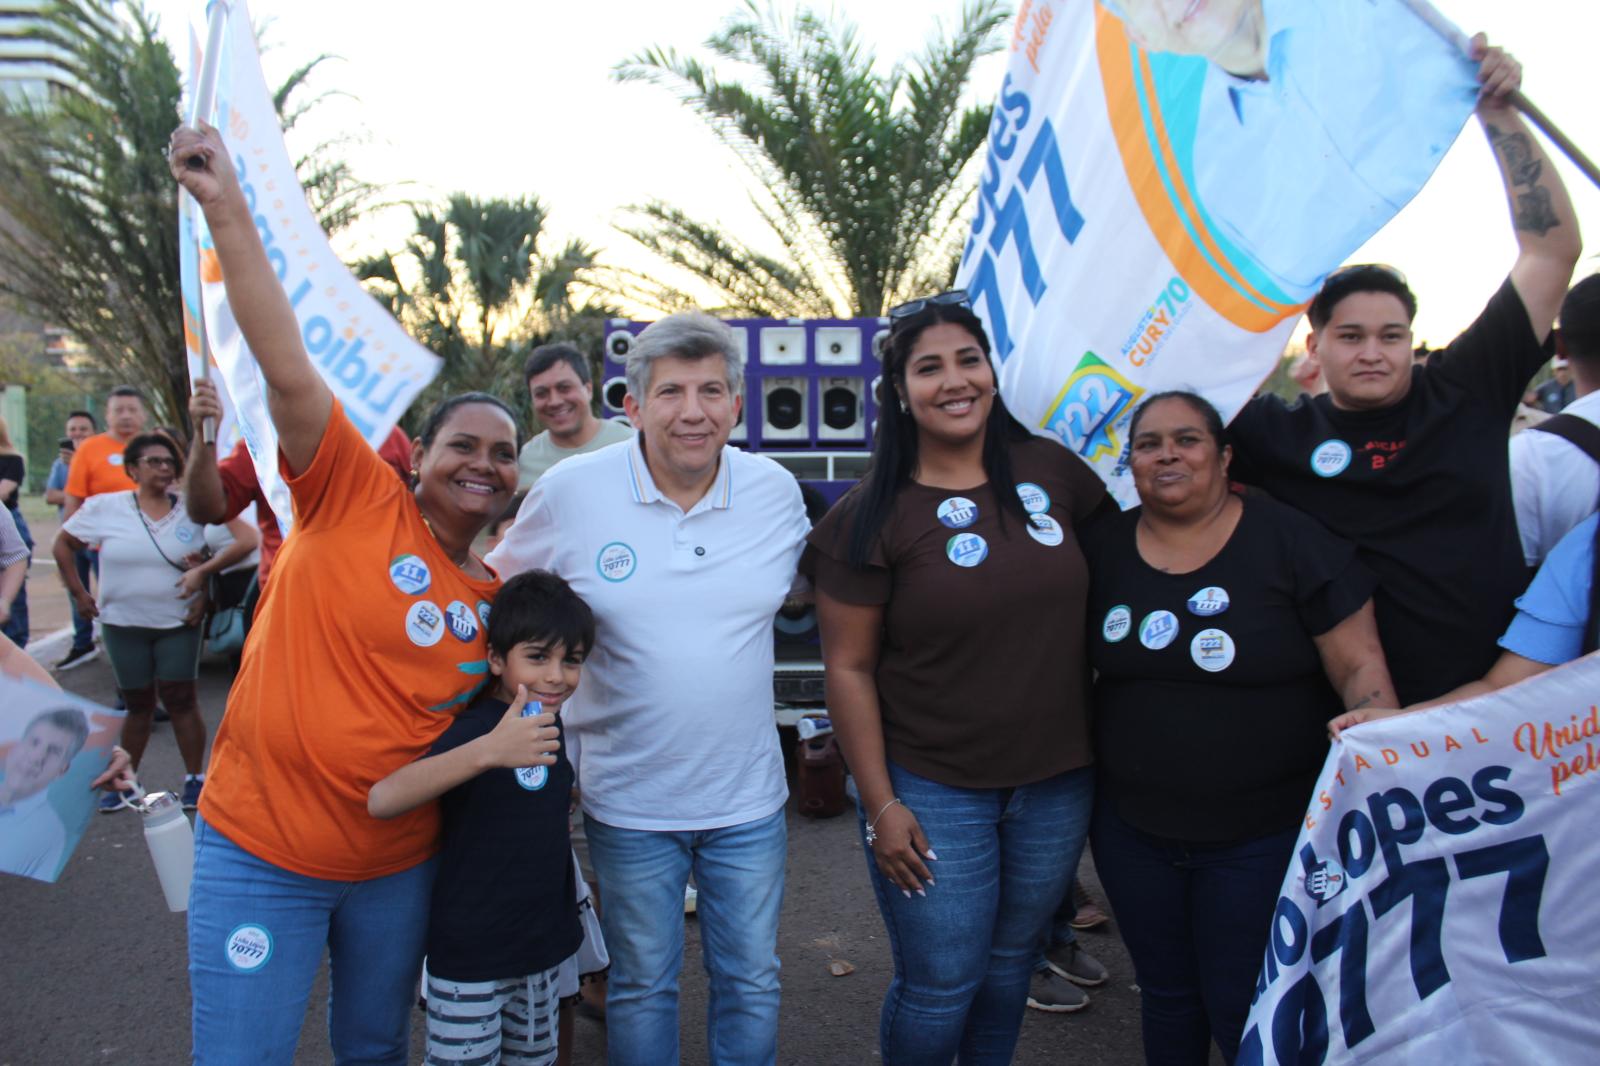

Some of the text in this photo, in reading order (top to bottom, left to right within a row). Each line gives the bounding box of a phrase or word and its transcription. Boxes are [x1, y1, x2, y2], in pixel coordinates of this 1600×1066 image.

[1129, 308, 1169, 367] CURY
[1155, 277, 1189, 317] 70
[603, 558, 630, 572] 70777
[1305, 727, 1489, 830] ESTADUAL
[1551, 742, 1600, 797] pel
[231, 943, 263, 959] 70777
